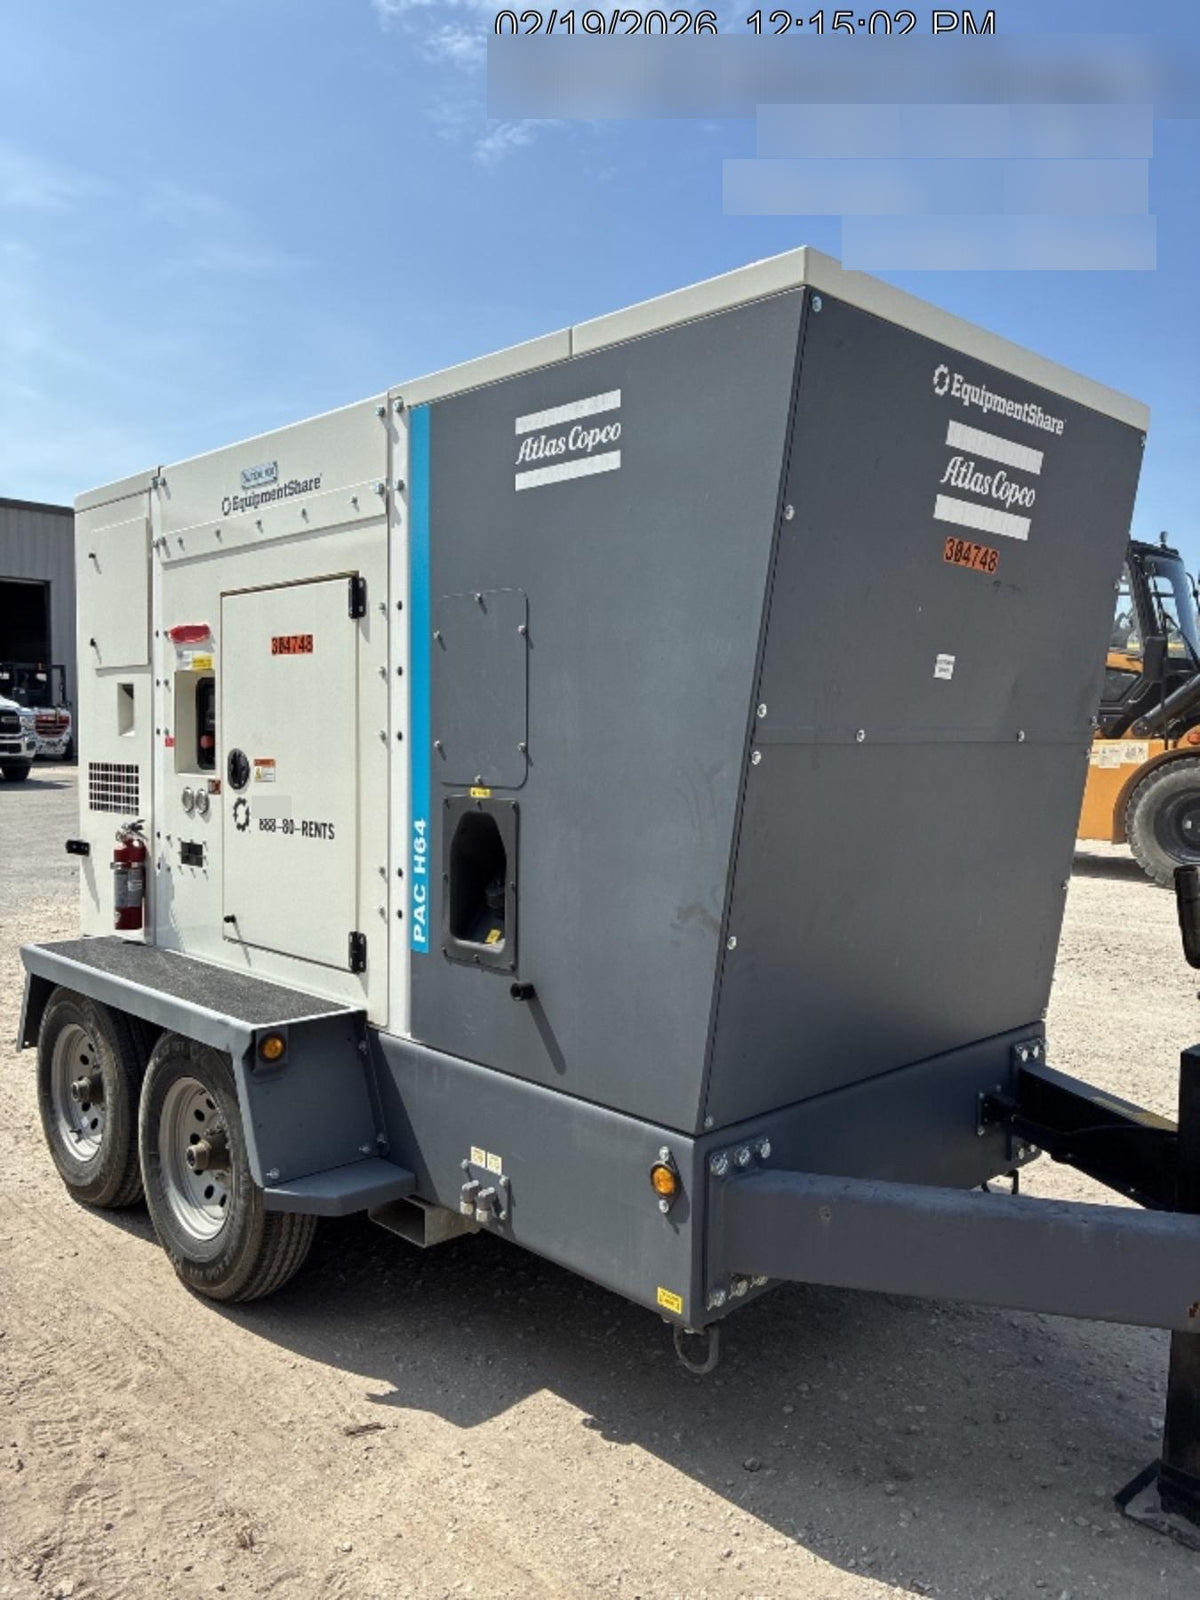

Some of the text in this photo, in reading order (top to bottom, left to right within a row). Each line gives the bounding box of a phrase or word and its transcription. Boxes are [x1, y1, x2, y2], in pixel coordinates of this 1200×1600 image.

[951, 372, 1064, 436] EquipmentShare
[514, 422, 621, 465] Atlas Copco
[232, 476, 321, 513] EquipmentShare
[940, 456, 1036, 509] Atlas Copco
[413, 819, 427, 943] PAC H64
